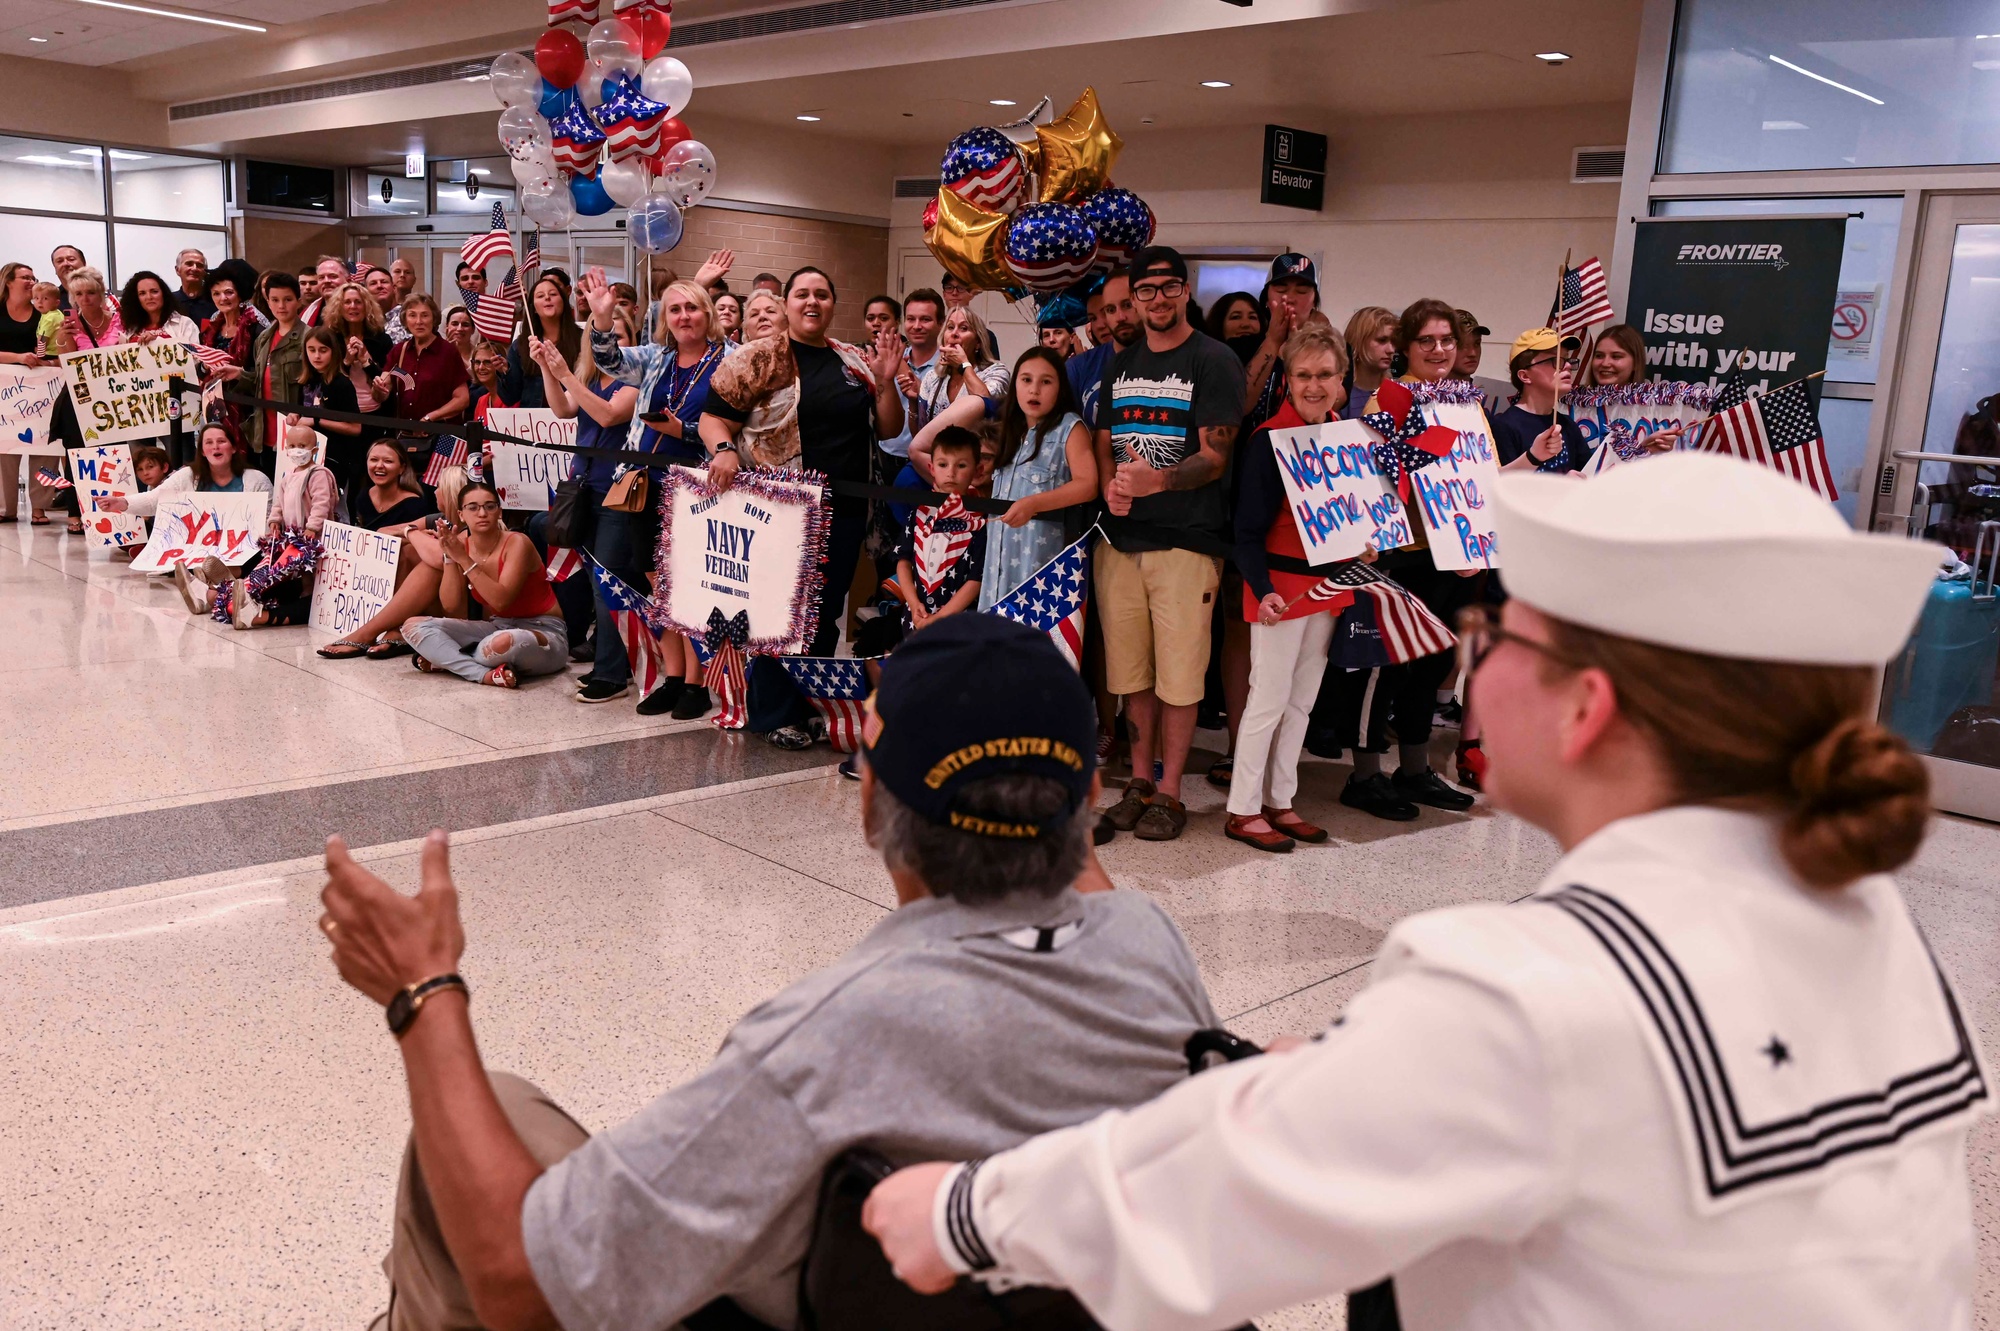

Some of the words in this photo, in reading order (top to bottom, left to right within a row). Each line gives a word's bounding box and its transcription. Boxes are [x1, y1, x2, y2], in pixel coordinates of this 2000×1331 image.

[408, 157, 422, 175] EXIT
[1271, 169, 1313, 189] Elevator
[1677, 244, 1783, 260] FRONTIER
[1643, 308, 1725, 335] Issue
[67, 344, 144, 382] THANK
[147, 343, 189, 369] YOU
[1644, 340, 1709, 368] with
[1714, 347, 1796, 374] your
[0, 375, 36, 401] ank
[108, 377, 127, 394] for
[1113, 389, 1156, 398] CHICAGO
[1159, 389, 1191, 399] ROOTS
[689, 495, 719, 516] WELCOME
[743, 502, 773, 525] HOME
[1413, 471, 1485, 530] Home
[1296, 492, 1365, 548] Home
[1362, 492, 1401, 528] love
[113, 528, 139, 546] PAPA
[322, 523, 353, 553] HOME
[355, 531, 371, 557] OF
[373, 535, 397, 565] THE
[706, 518, 756, 562] NAVY
[318, 556, 349, 590] FREE
[352, 563, 391, 602] because
[704, 553, 750, 584] VETERAN
[733, 588, 751, 600] SERVICE
[923, 743, 985, 790] UNITED
[984, 736, 1052, 757] STATES
[950, 810, 1041, 838] VETERAN
